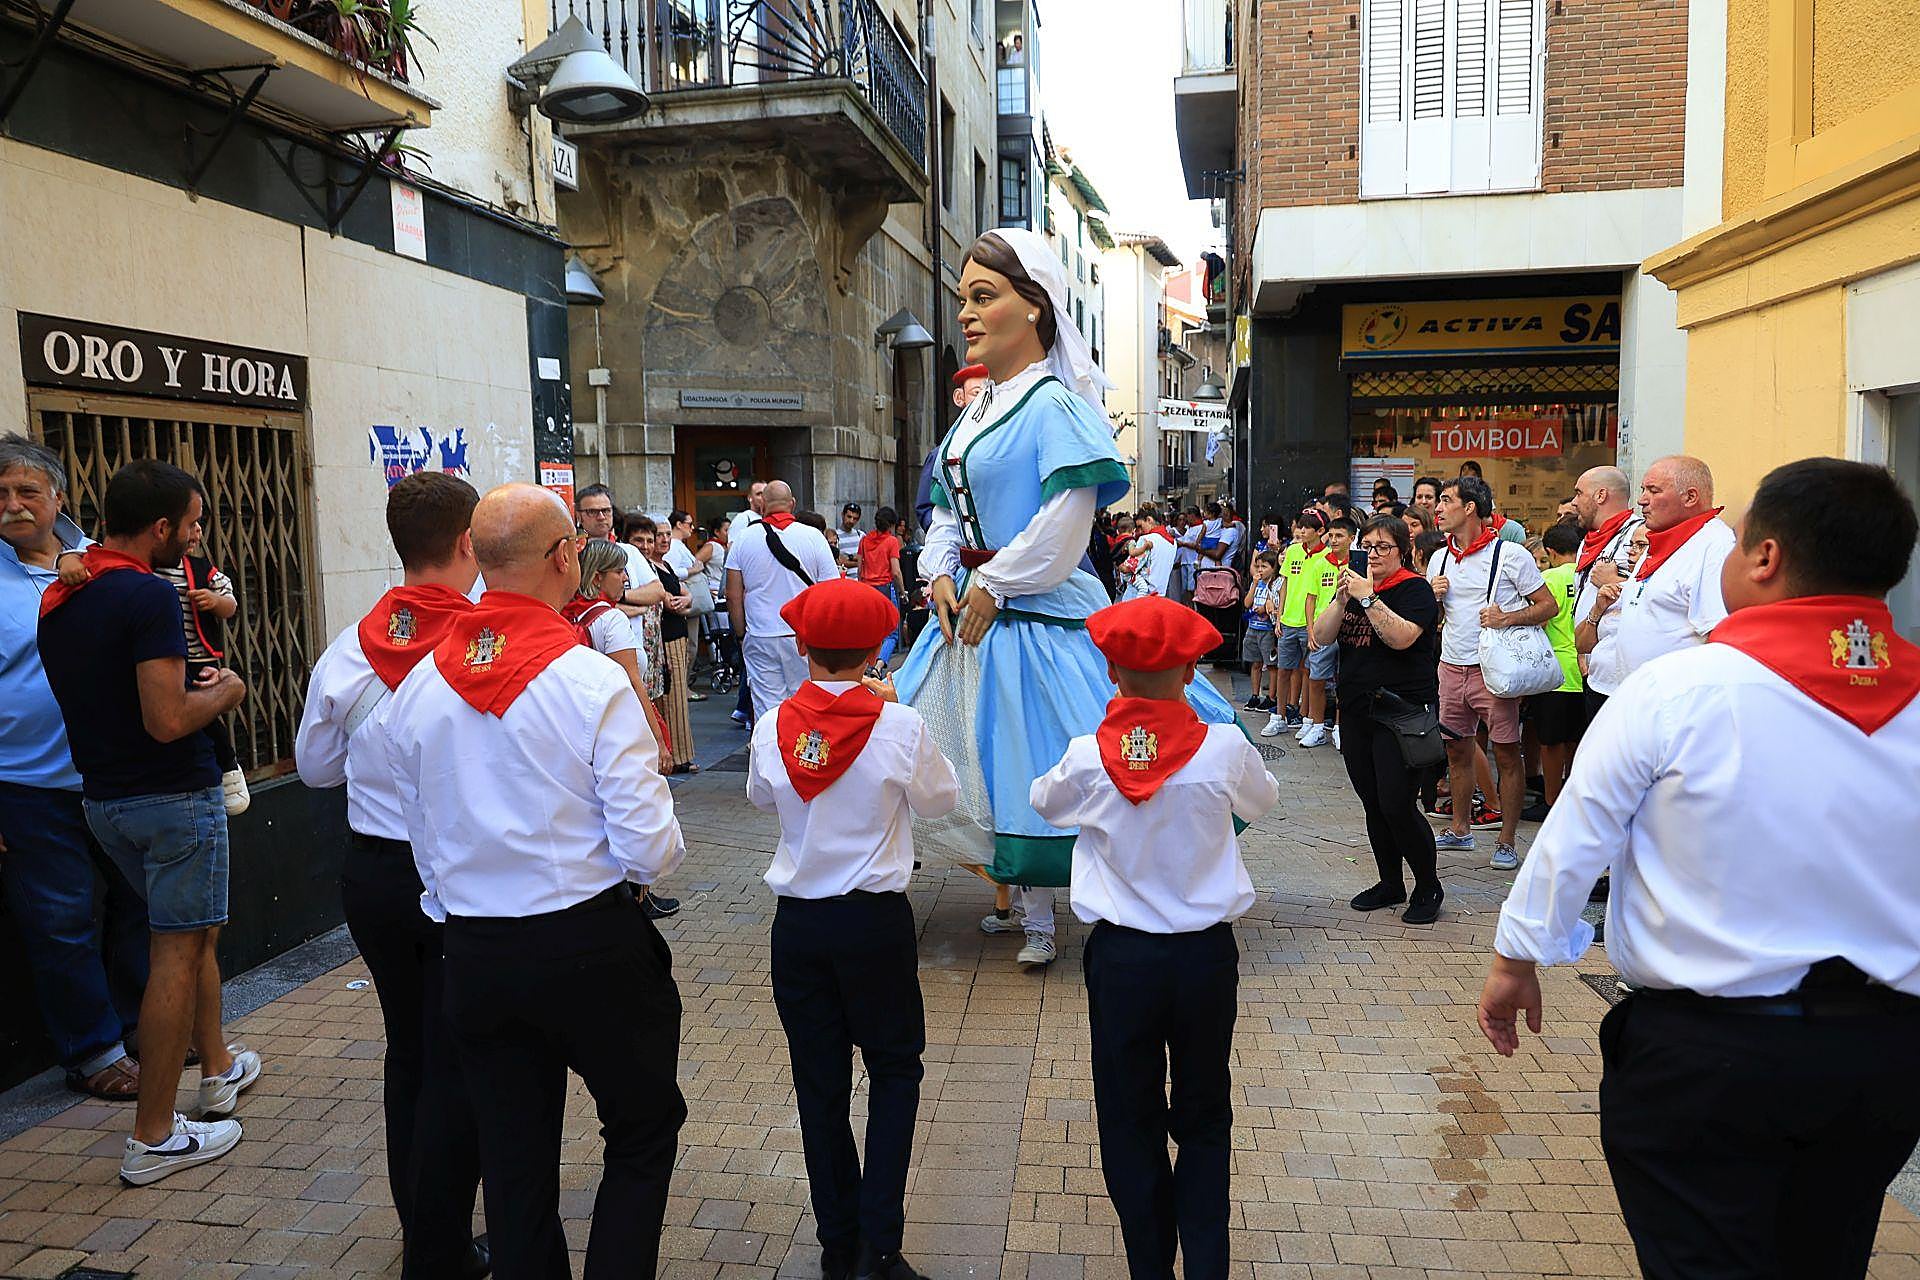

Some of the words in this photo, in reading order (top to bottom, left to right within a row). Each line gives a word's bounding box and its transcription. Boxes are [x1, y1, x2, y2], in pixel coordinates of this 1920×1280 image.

[1417, 316, 1543, 334] ACTIVA
[1559, 302, 1621, 343] SA
[43, 330, 144, 382] ORO
[158, 345, 188, 388] Y
[201, 352, 298, 401] HORA
[1194, 419, 1208, 427] EZ!
[1431, 424, 1559, 452] TÓMBOLA
